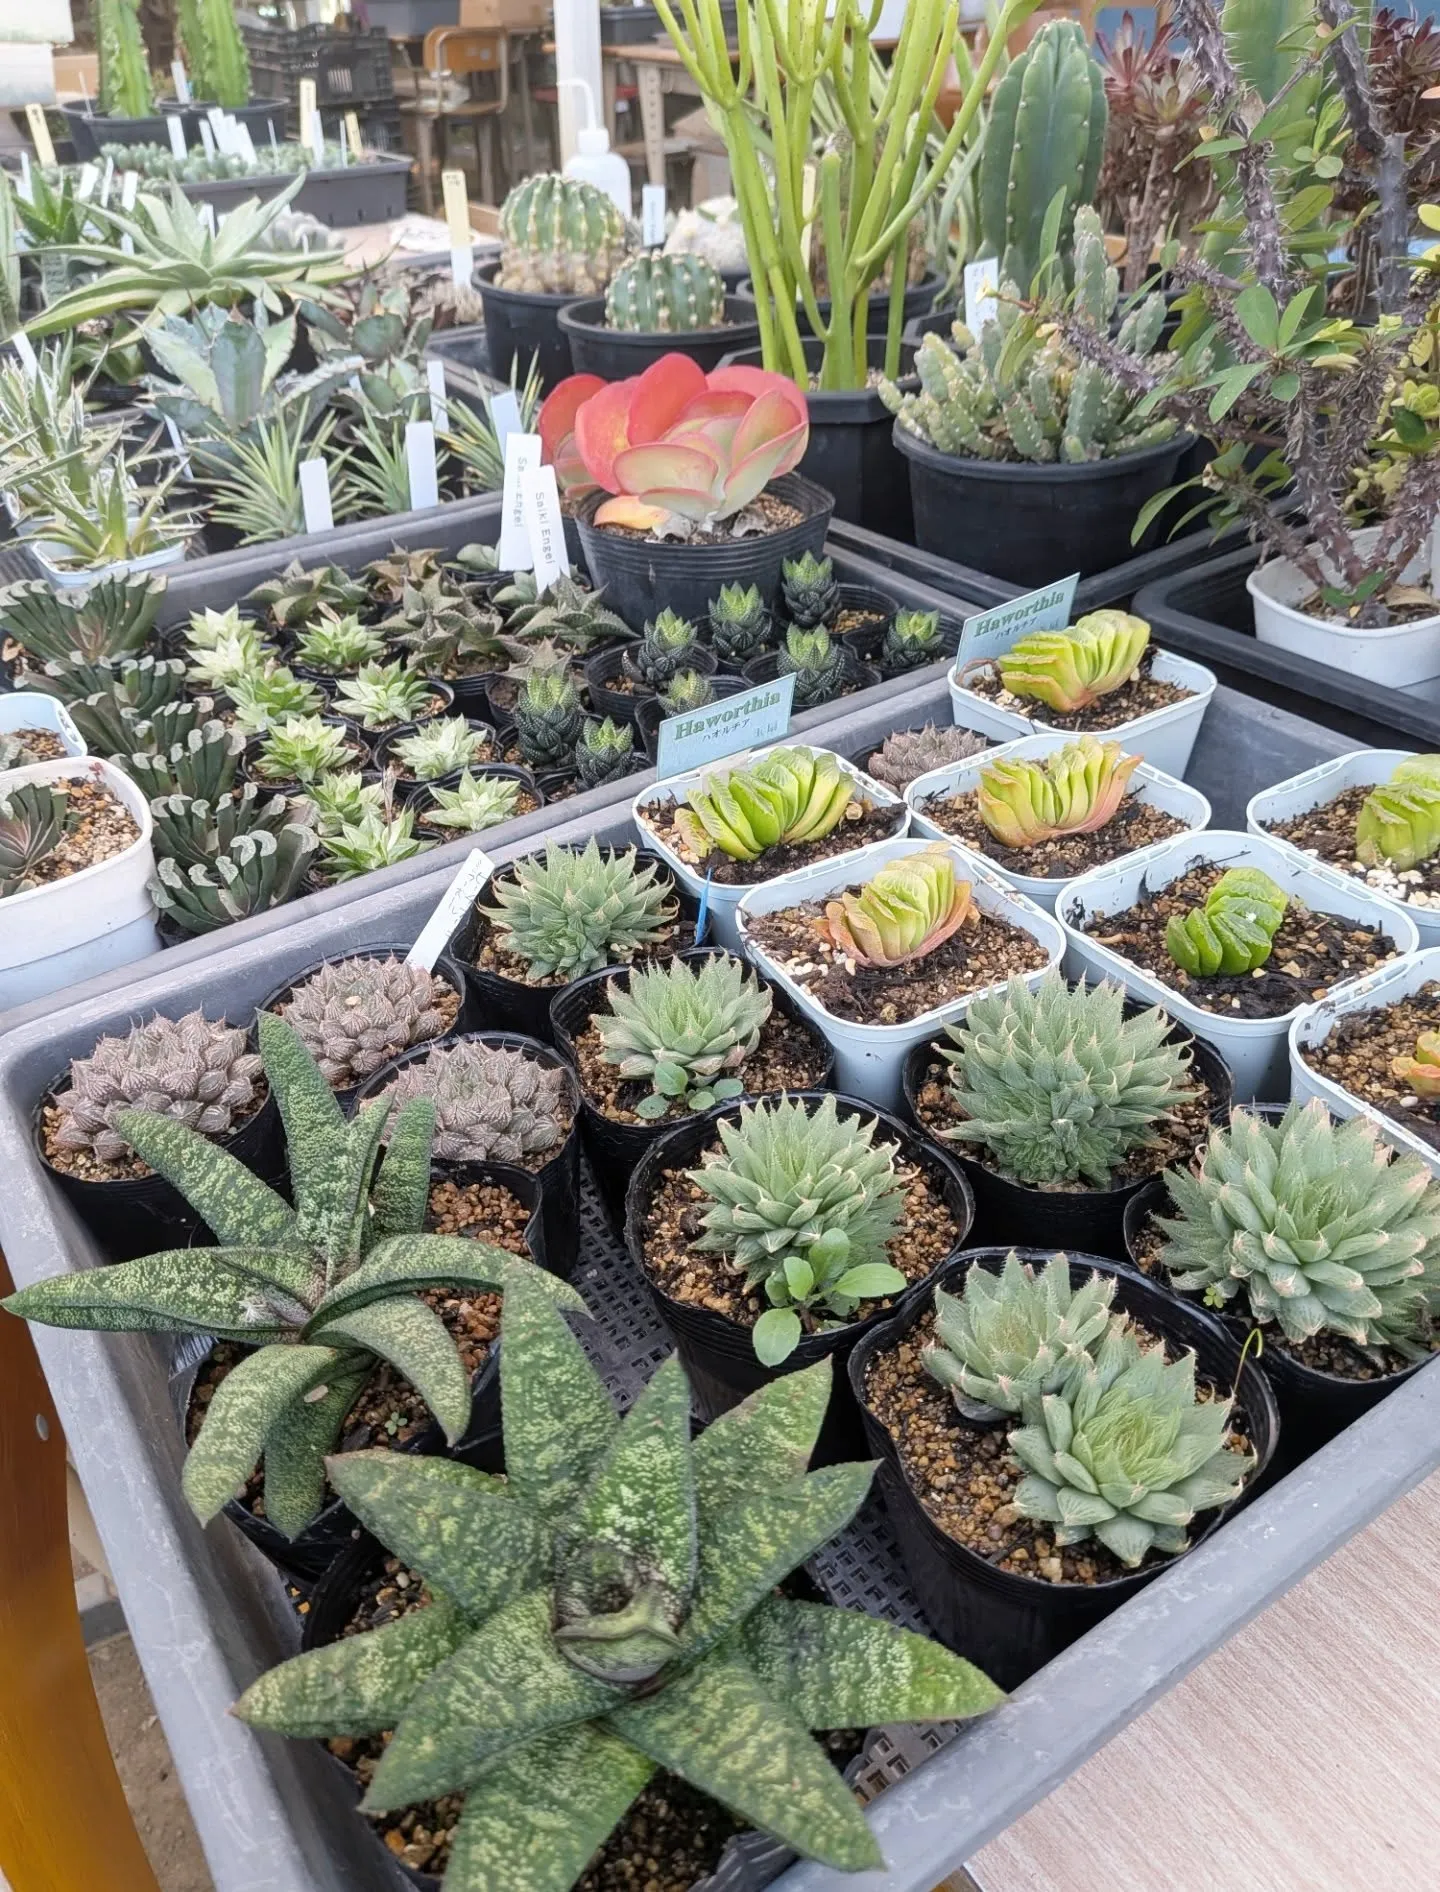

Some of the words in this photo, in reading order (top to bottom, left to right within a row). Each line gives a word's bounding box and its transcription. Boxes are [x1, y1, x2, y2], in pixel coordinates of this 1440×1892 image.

[974, 591, 1065, 638] Haworthia
[674, 691, 781, 741] Haworthia
[702, 718, 751, 742] ハオルチア
